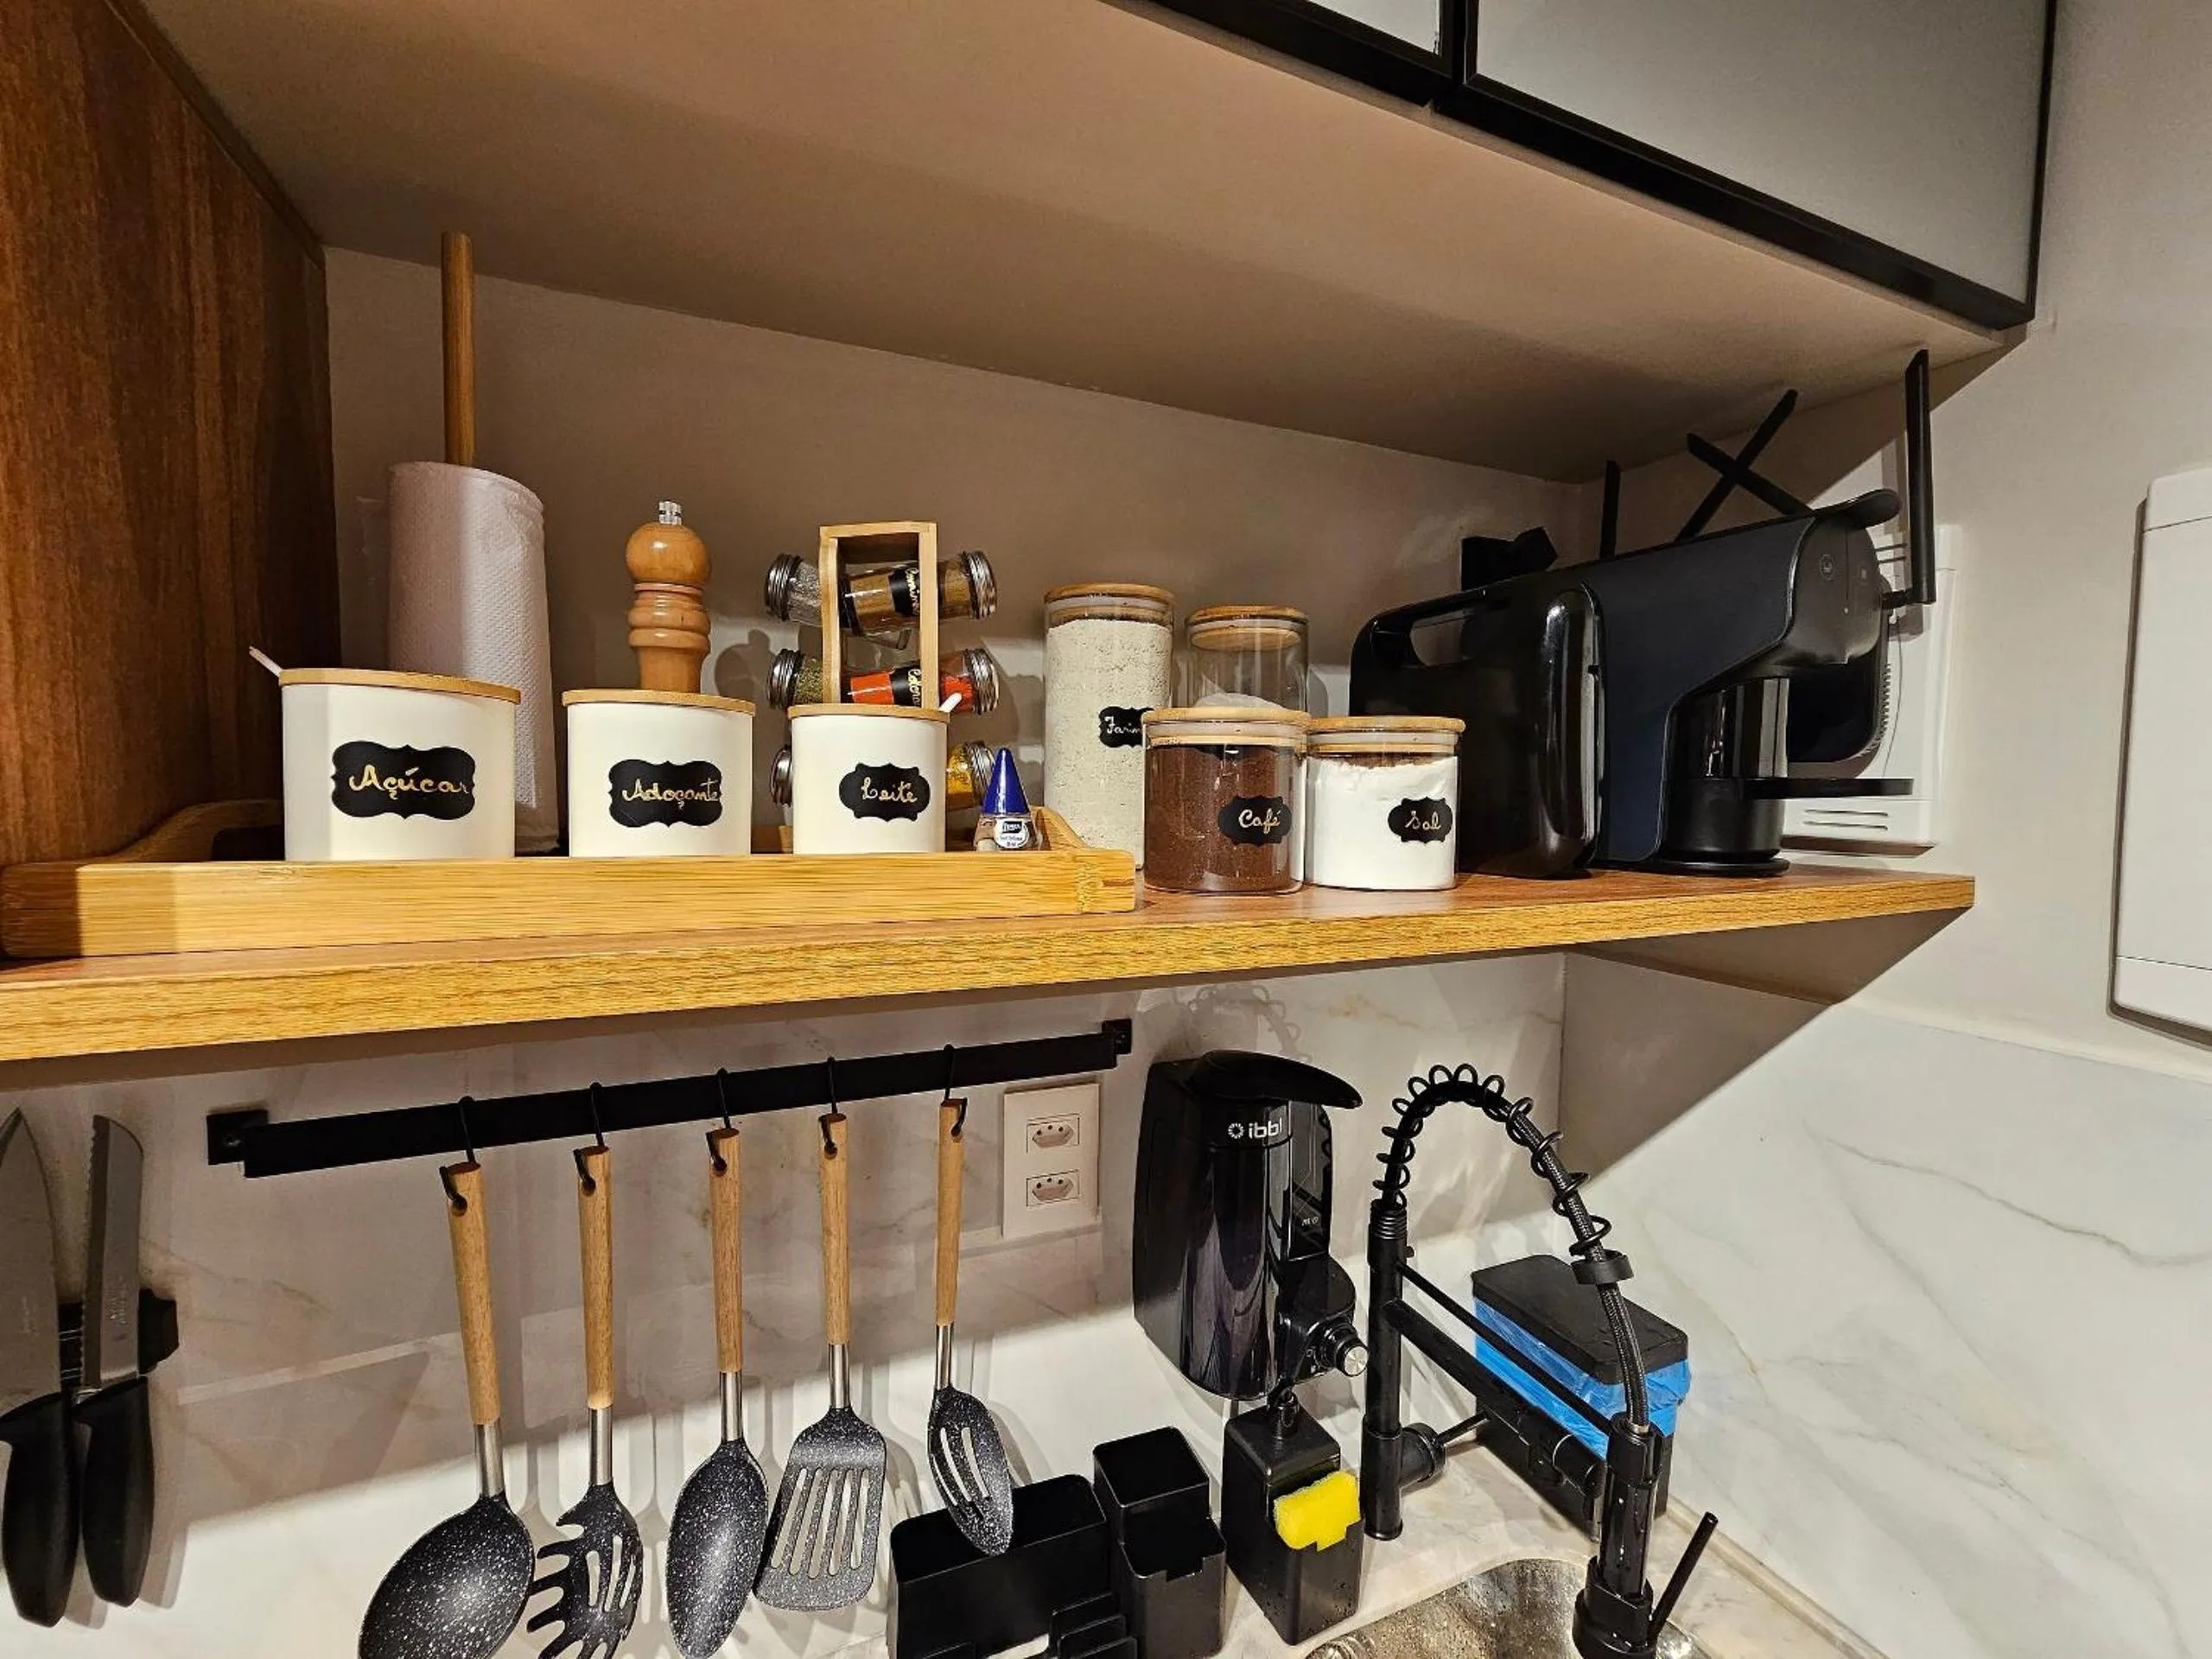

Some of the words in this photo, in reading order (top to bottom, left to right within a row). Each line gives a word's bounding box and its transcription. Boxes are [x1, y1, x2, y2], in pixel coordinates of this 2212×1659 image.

[348, 764, 470, 800] Açúcar
[621, 778, 719, 810] Adoçante
[861, 777, 918, 804] Leite
[1238, 808, 1281, 835] Café
[1404, 810, 1441, 830] Sal
[1249, 1116, 1282, 1139] ibbl
